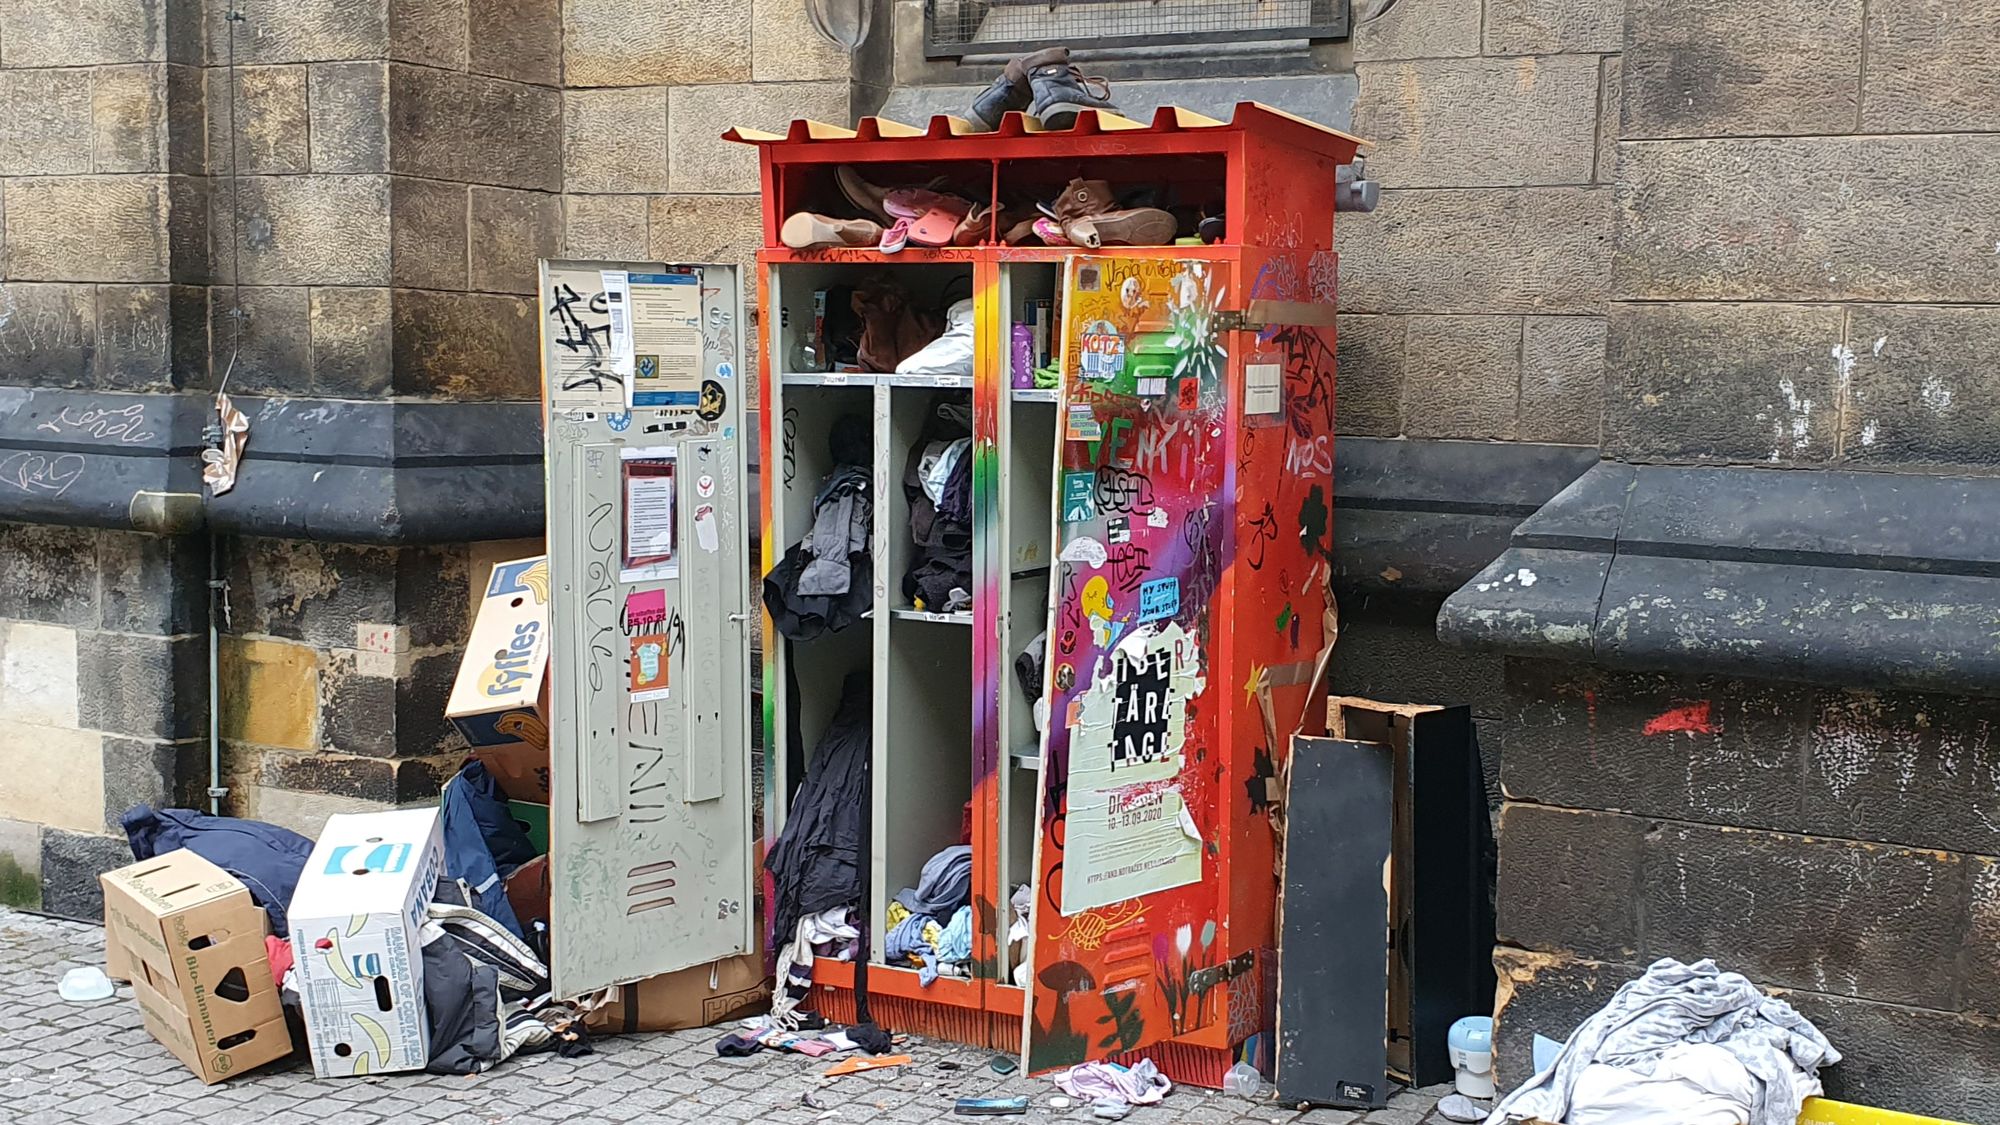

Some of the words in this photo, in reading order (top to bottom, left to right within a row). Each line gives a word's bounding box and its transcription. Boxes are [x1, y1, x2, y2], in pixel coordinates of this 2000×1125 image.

[1142, 585, 1155, 596] MY
[1156, 580, 1177, 593] STUFF
[1143, 595, 1152, 606] IS
[1142, 605, 1160, 618] YOUR
[1161, 598, 1178, 613] STUFF
[1111, 684, 1175, 729] TÄRE
[1107, 731, 1172, 772] TAGE
[410, 844, 440, 928] COBANA
[390, 926, 409, 981] BANANAS
[185, 956, 217, 1046] Bio-Bananen
[400, 982, 412, 997] OF
[402, 1000, 418, 1037] COSTA
[409, 1039, 423, 1067] RICA
